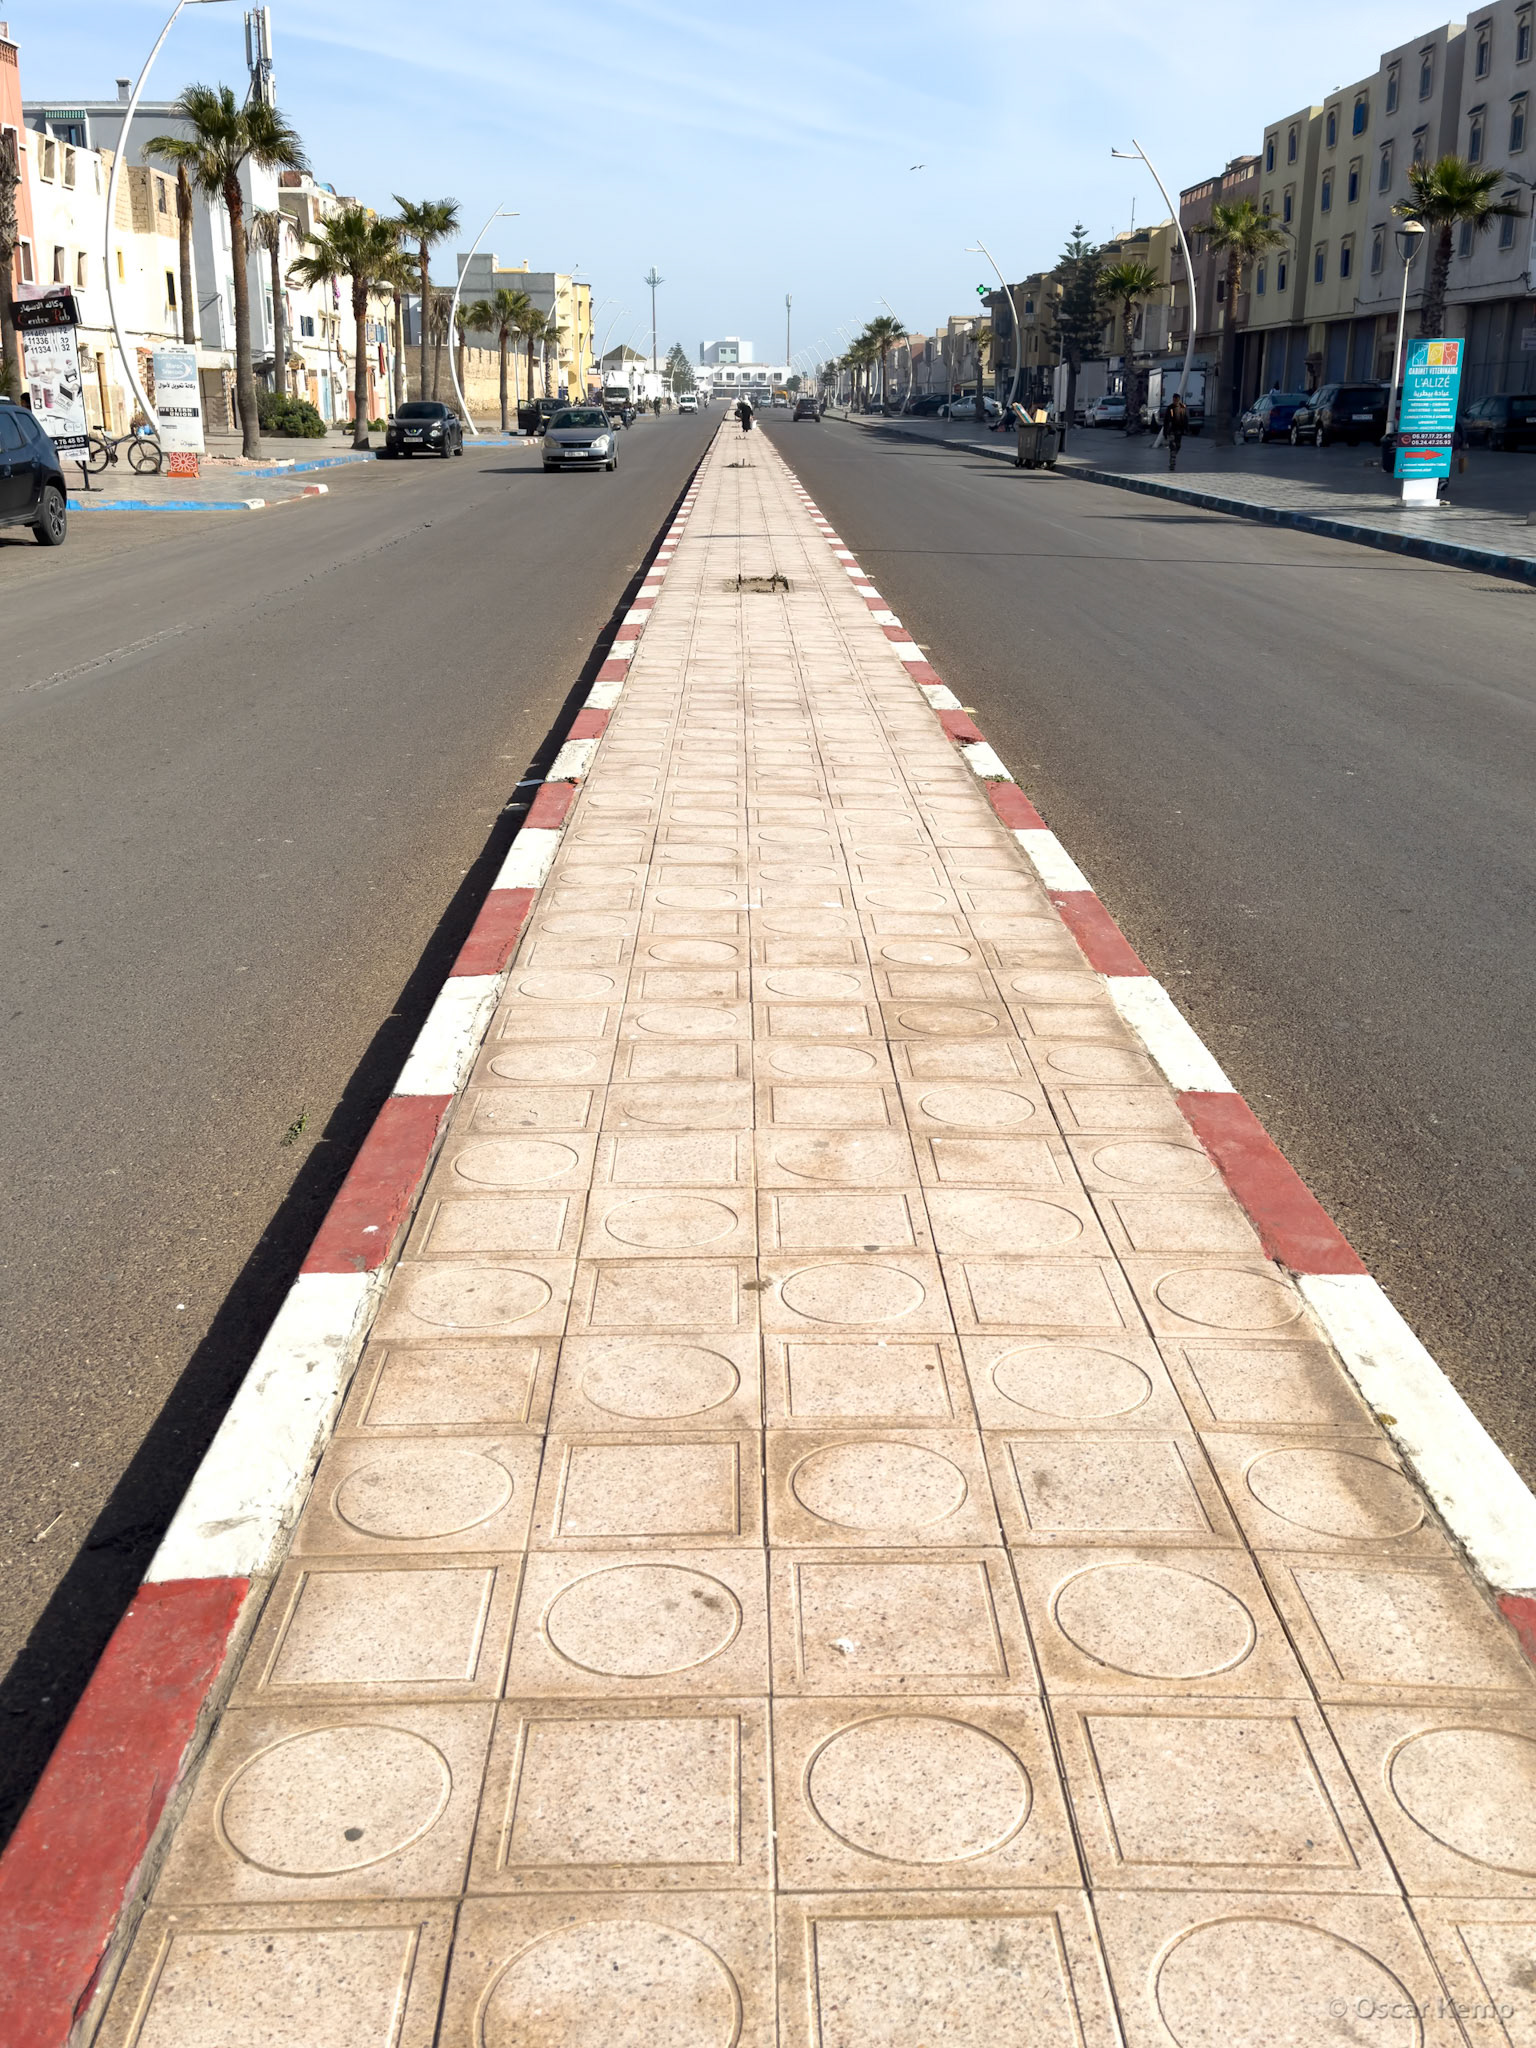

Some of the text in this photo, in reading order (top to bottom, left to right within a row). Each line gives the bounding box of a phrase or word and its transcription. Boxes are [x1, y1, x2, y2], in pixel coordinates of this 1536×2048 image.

[28, 337, 49, 345] 11336
[30, 345, 52, 354] 11334
[61, 343, 71, 352] 32
[1414, 375, 1450, 388] L'ALIZÉ
